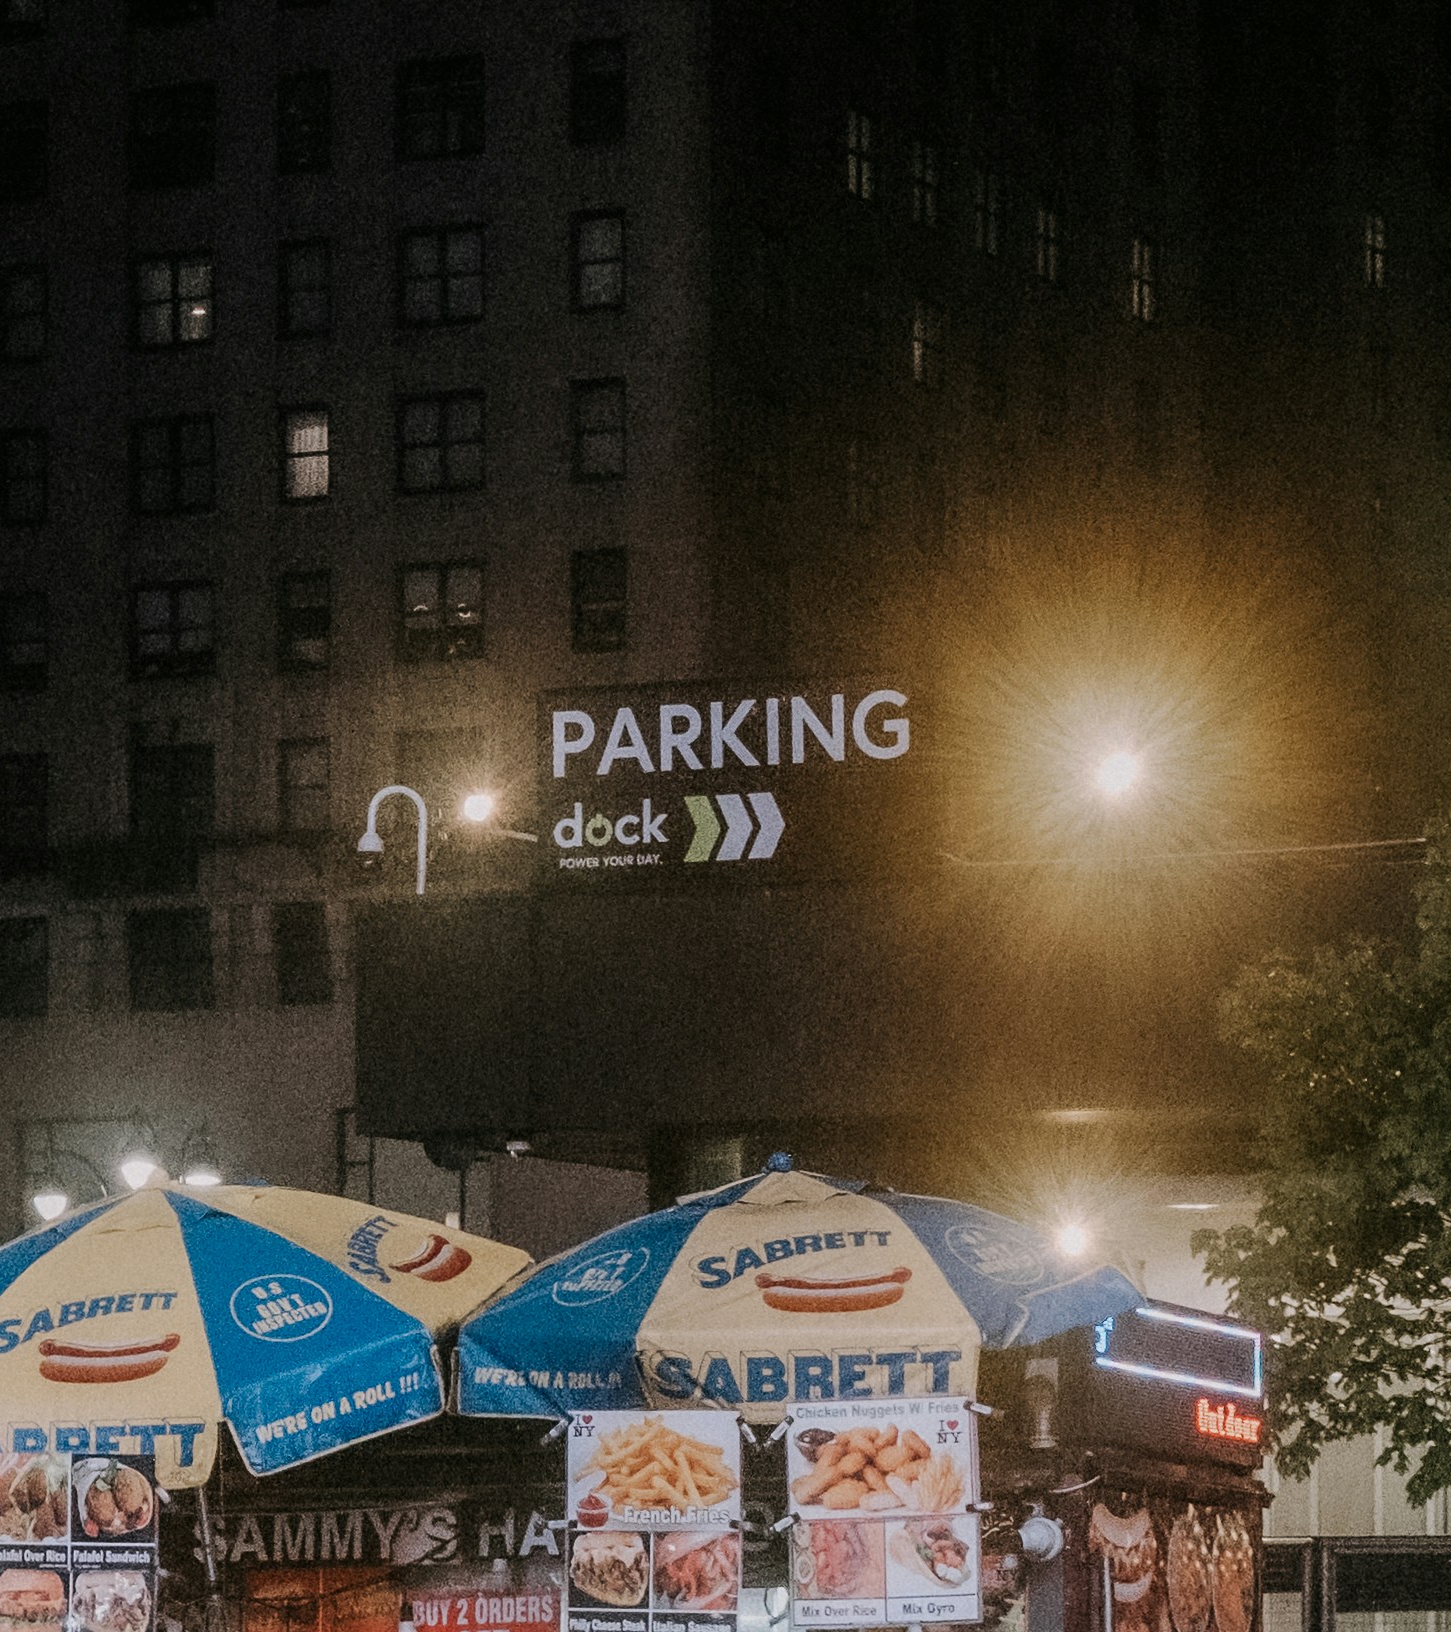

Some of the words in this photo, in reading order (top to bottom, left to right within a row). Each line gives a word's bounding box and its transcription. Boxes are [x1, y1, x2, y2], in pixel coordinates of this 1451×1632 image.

[552, 689, 911, 778] PARKING
[553, 798, 670, 849] dock
[559, 857, 599, 870] POWER
[603, 854, 634, 867] YOUR
[347, 1214, 399, 1284] SABRETT
[697, 1229, 893, 1289] SABRETT
[252, 1301, 328, 1335] INSPECTED
[552, 1371, 564, 1390] A
[653, 1350, 963, 1403] SABRETT
[255, 1416, 308, 1445] WE'RE
[311, 1403, 336, 1424] ON
[339, 1396, 352, 1416] A
[352, 1380, 396, 1410] ROLL
[796, 1405, 848, 1420] Chicken
[850, 1404, 906, 1420] Nuggets
[927, 1402, 960, 1416] Fries
[573, 1424, 596, 1438] NY
[936, 1431, 962, 1445] NY
[623, 1505, 681, 1525] French
[687, 1506, 731, 1526] Fries
[193, 1507, 459, 1566] SAMMY'S
[23, 1549, 44, 1563] Over
[46, 1549, 67, 1563] Rice
[73, 1549, 103, 1563] Falafel
[104, 1549, 151, 1564] Sandwich
[412, 1599, 450, 1627] BUY
[456, 1599, 470, 1625] 2
[474, 1596, 555, 1625] ORDERS
[801, 1605, 820, 1617] Mix
[824, 1604, 849, 1617] Over
[852, 1604, 877, 1617] Rice
[901, 1602, 923, 1615] Mix
[926, 1602, 955, 1618] Gyro
